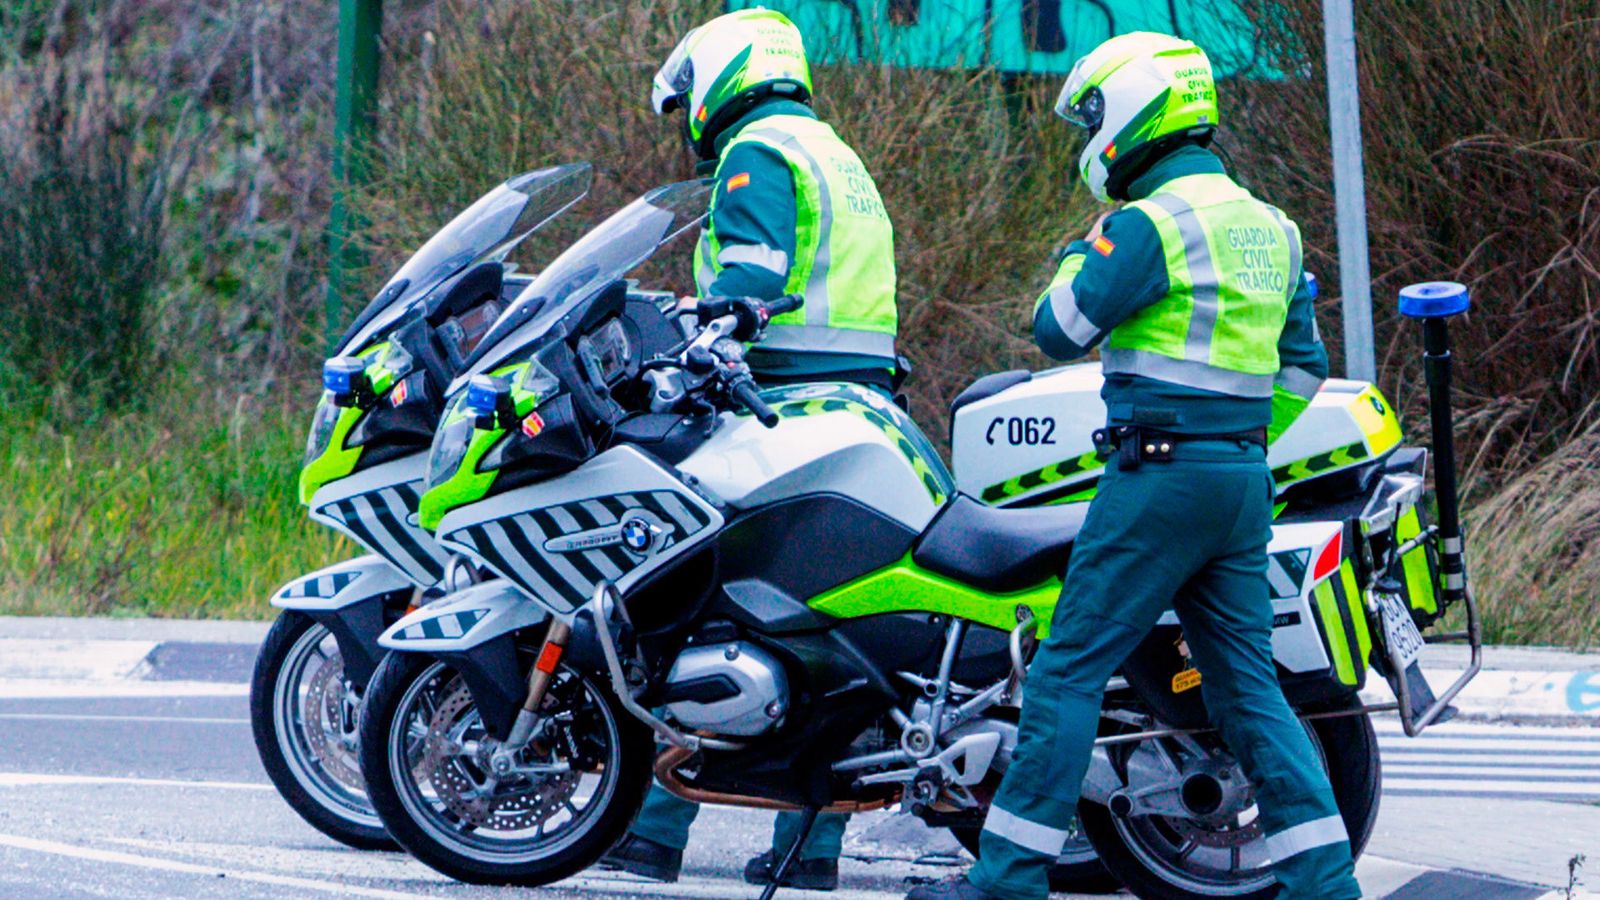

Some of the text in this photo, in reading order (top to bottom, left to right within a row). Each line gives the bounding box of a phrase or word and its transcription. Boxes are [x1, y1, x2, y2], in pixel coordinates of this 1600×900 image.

[1187, 80, 1207, 90] CIVIL
[1182, 91, 1213, 103] TRAFICO
[1227, 228, 1277, 248] GUARDIA
[1242, 248, 1273, 270] CIVIL
[1235, 270, 1284, 293] TRAFICO
[1008, 416, 1056, 446] 062
[1392, 619, 1422, 659] 9520
